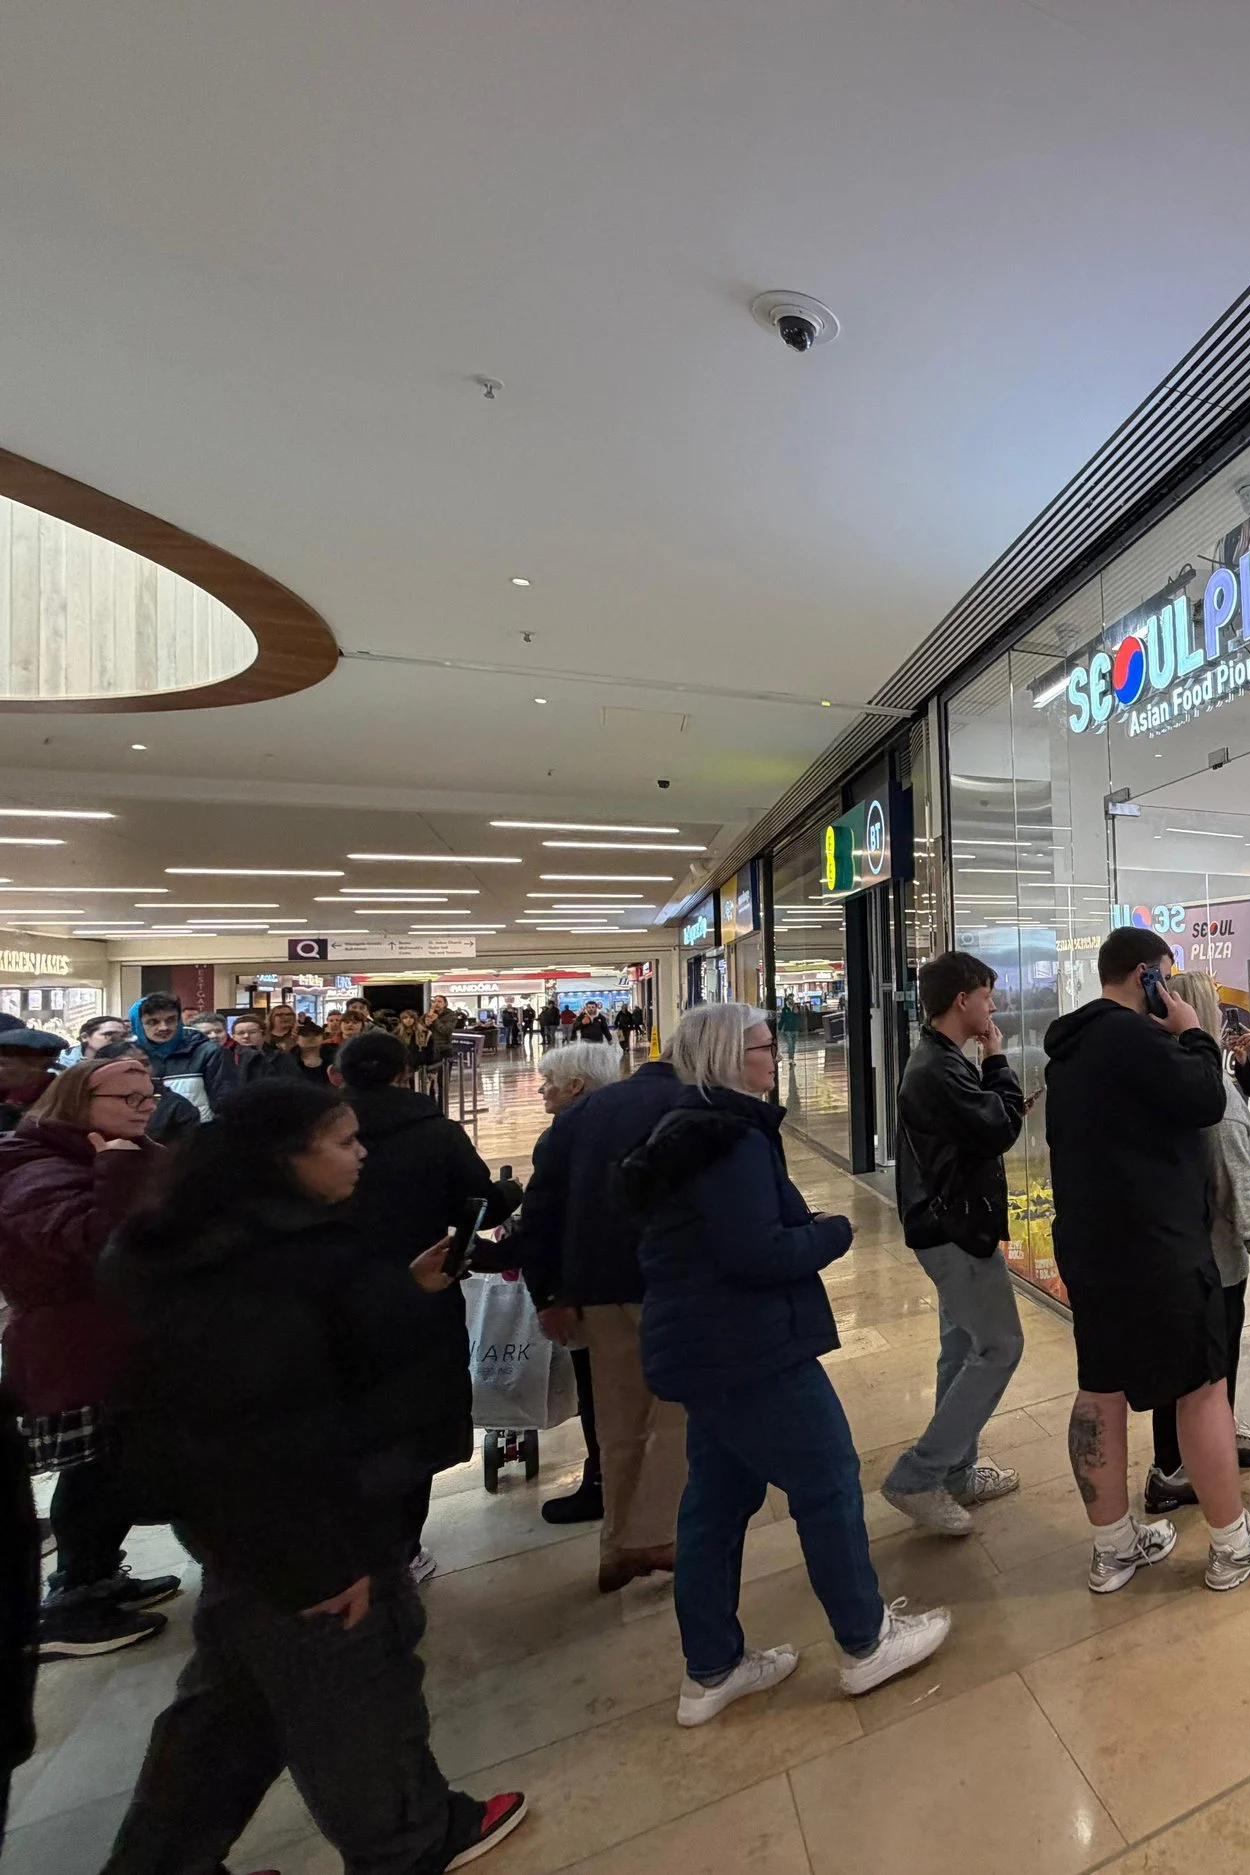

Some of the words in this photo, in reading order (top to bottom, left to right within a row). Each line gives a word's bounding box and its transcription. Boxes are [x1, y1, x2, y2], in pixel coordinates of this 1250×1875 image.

[1068, 595, 1205, 734] SEOUL
[1129, 702, 1169, 737] Asian
[1173, 672, 1212, 716] Food
[870, 822, 881, 852] BT
[1192, 920, 1235, 938] SEOUL
[1191, 941, 1232, 960] PLAZA
